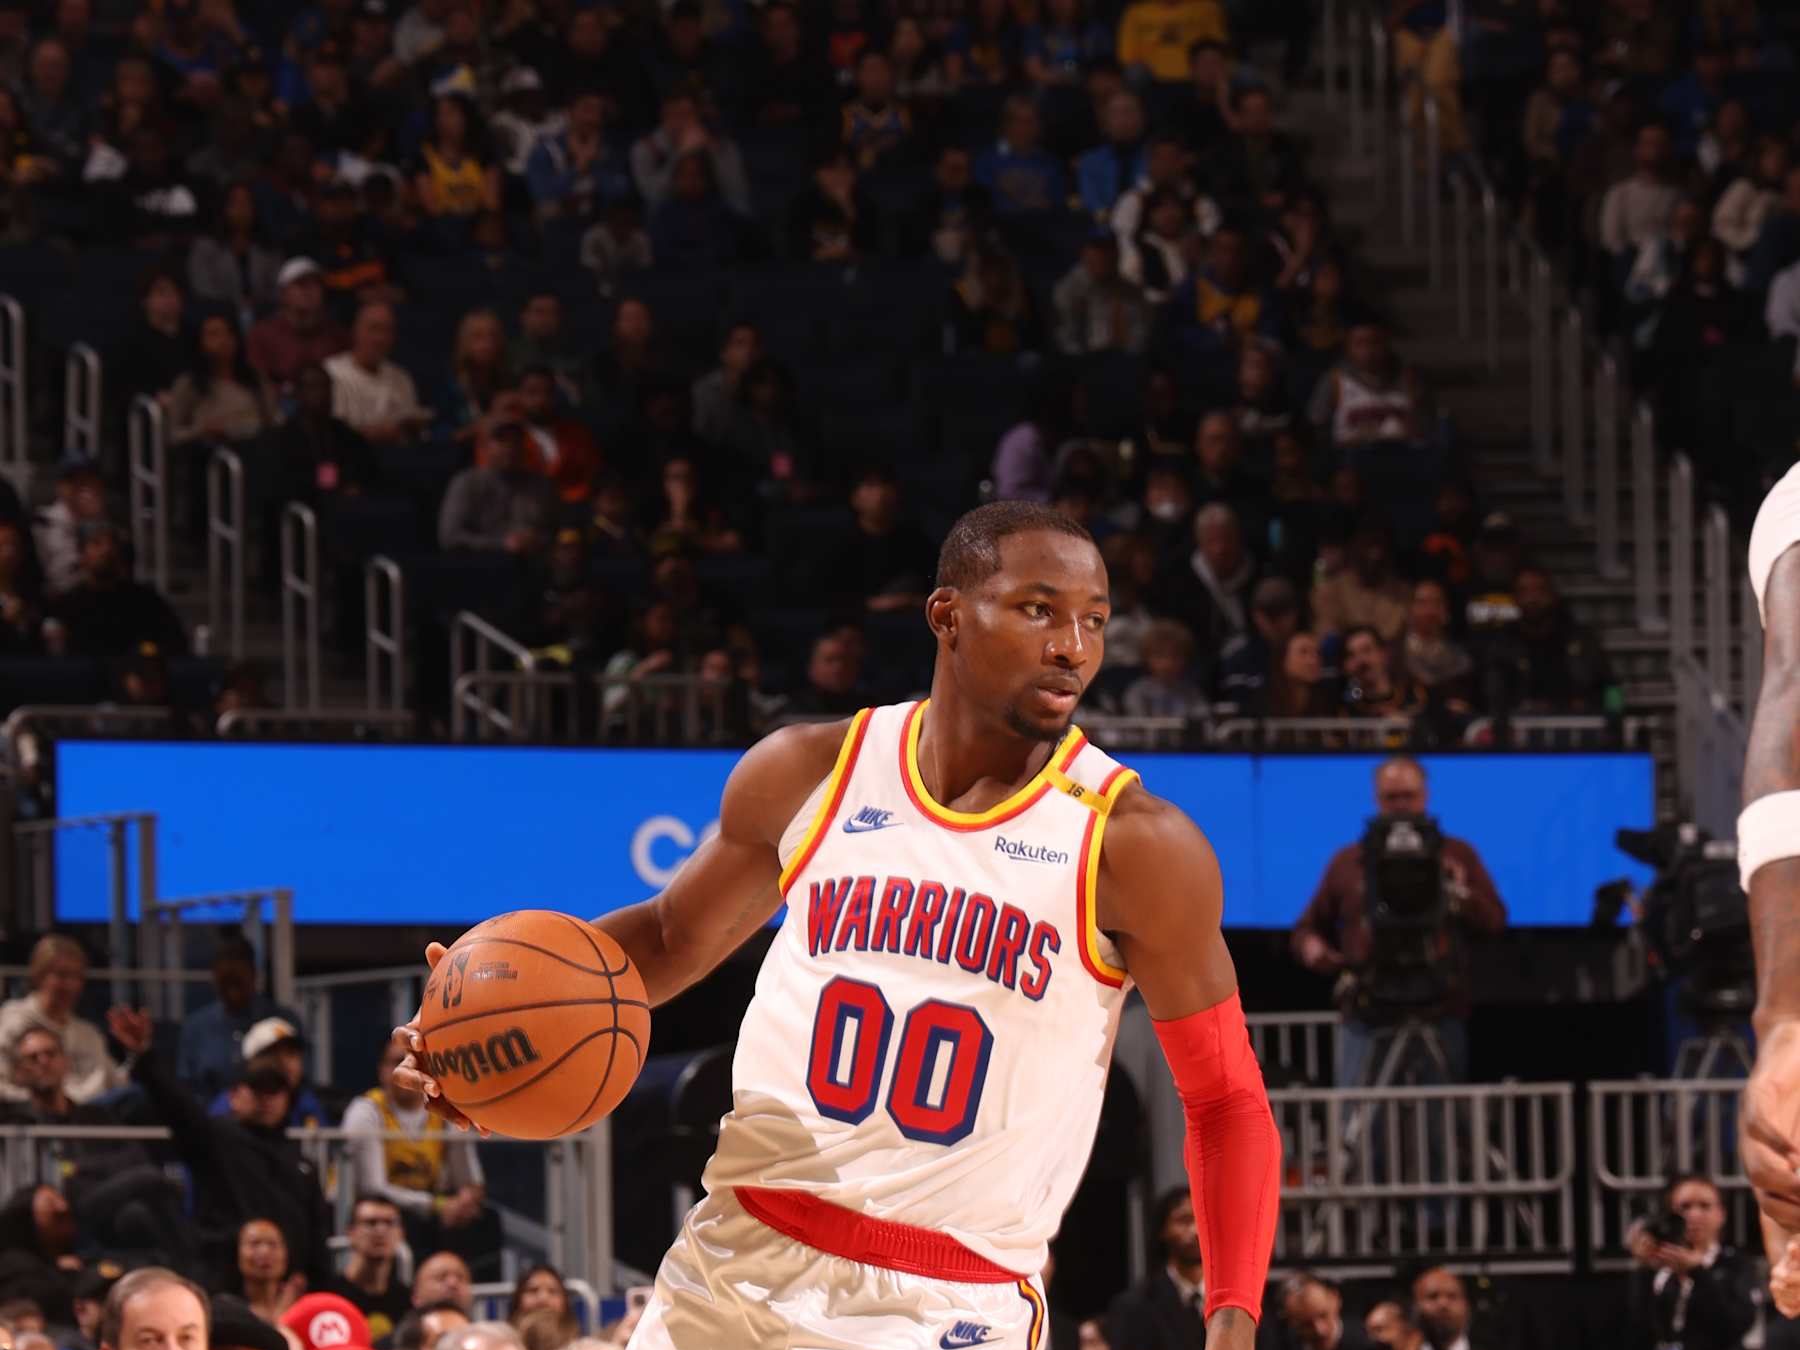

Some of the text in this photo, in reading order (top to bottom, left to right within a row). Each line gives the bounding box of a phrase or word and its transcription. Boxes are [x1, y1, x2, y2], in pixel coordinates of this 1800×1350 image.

[1066, 783, 1085, 798] 16
[855, 806, 894, 827] NIKE
[994, 835, 1069, 864] Rakuten
[807, 875, 1060, 1002] WARRIORS
[428, 1027, 541, 1084] Wilso
[806, 975, 994, 1147] 00
[949, 1319, 992, 1341] NIKE
